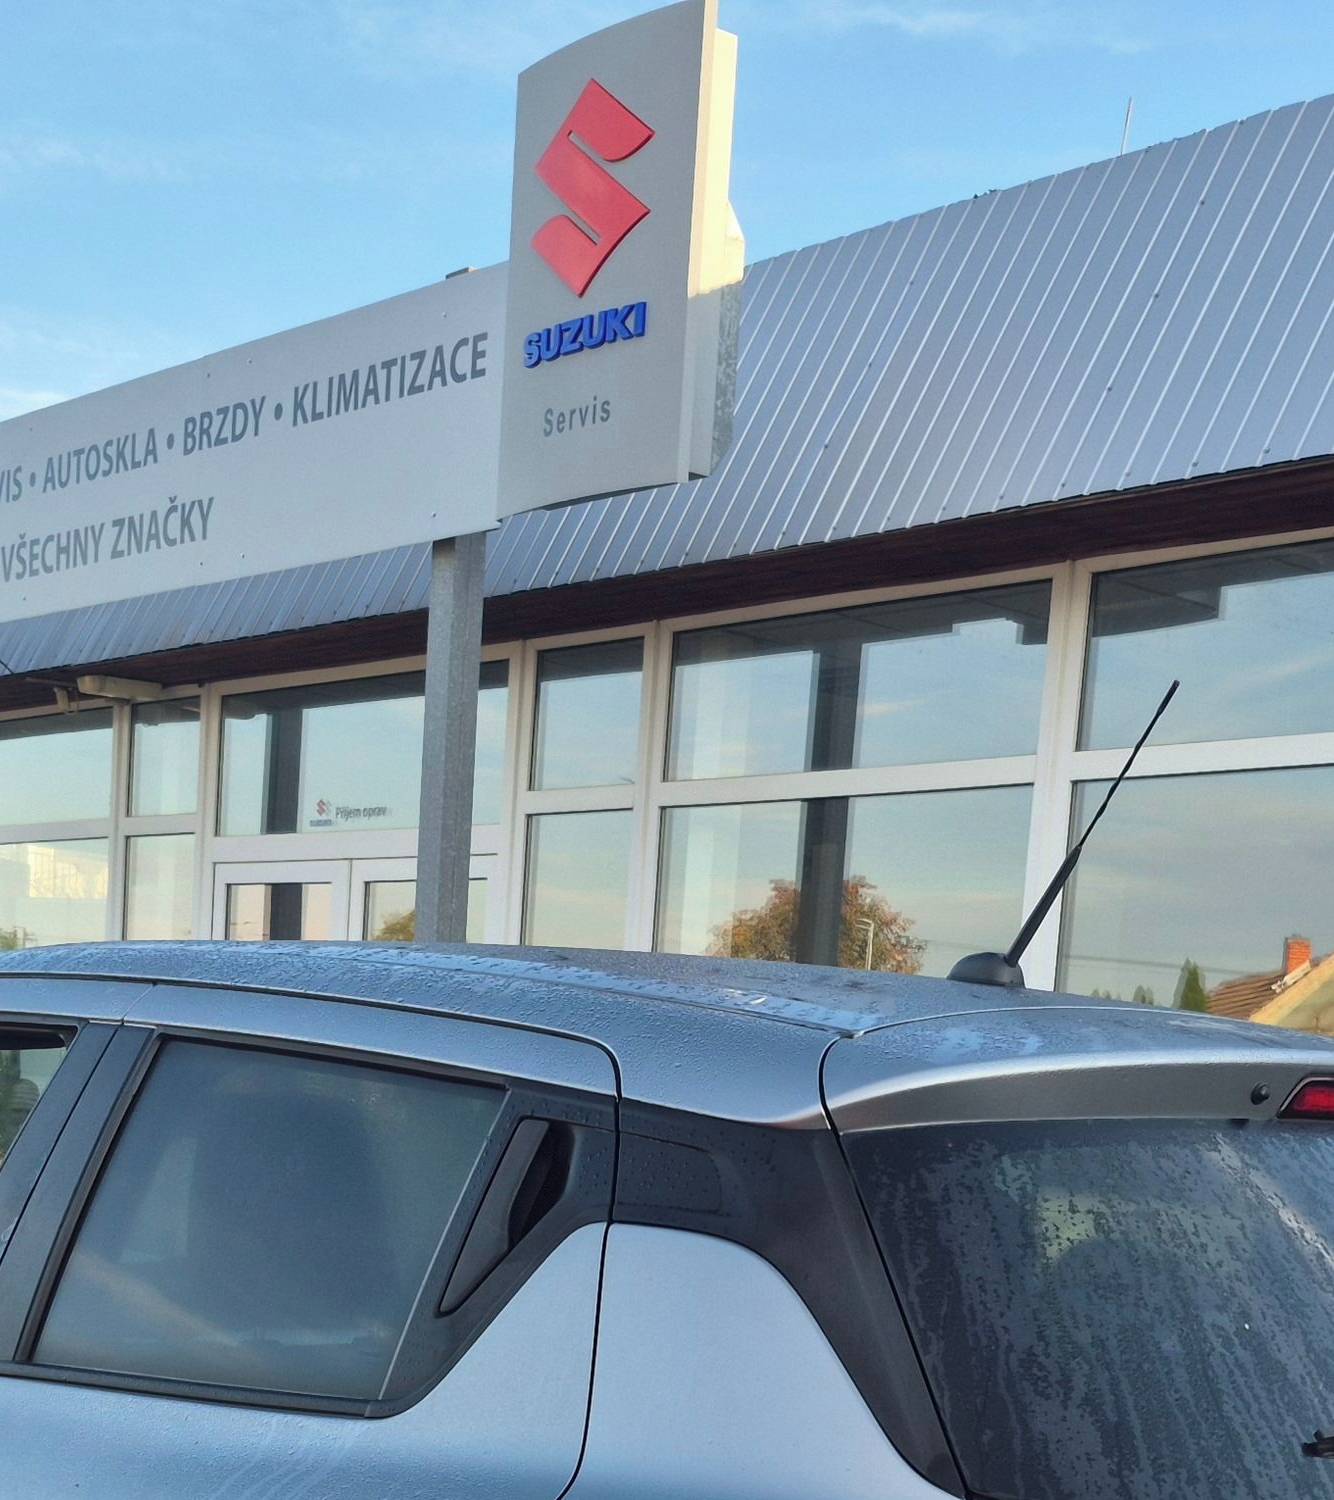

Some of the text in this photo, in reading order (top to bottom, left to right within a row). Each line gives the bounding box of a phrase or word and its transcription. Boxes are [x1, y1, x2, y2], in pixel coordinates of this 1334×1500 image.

[524, 301, 647, 368] SUZUKI
[42, 427, 158, 494] AUTOSKLA
[182, 395, 267, 456] BRZDY
[292, 332, 488, 426] KLIMATIZACE
[543, 396, 611, 437] Servis
[1, 525, 105, 584] VŠECHNY
[111, 495, 215, 561] ZNAČKY
